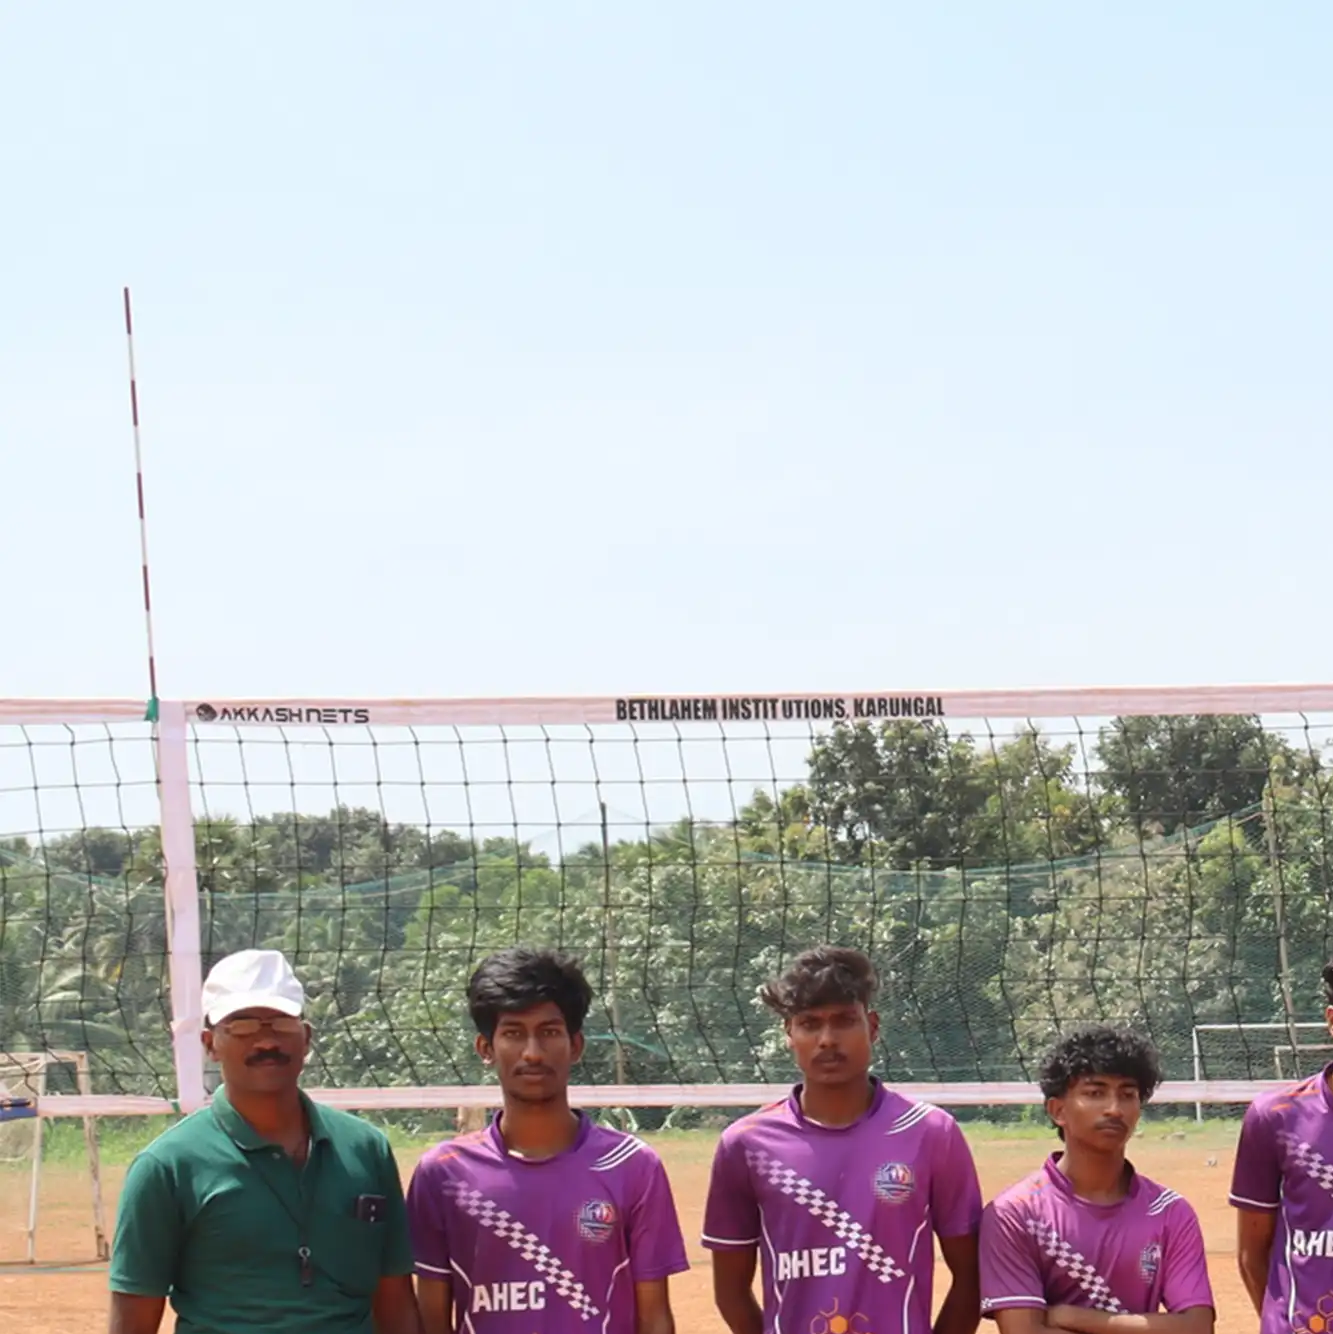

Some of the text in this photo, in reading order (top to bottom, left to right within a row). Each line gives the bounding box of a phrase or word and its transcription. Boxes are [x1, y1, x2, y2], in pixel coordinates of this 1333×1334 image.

[616, 699, 718, 721] BETHLAHEM
[854, 696, 945, 718] KARUNGAL
[777, 1246, 847, 1282] AHEC
[472, 1280, 547, 1314] AHEC
